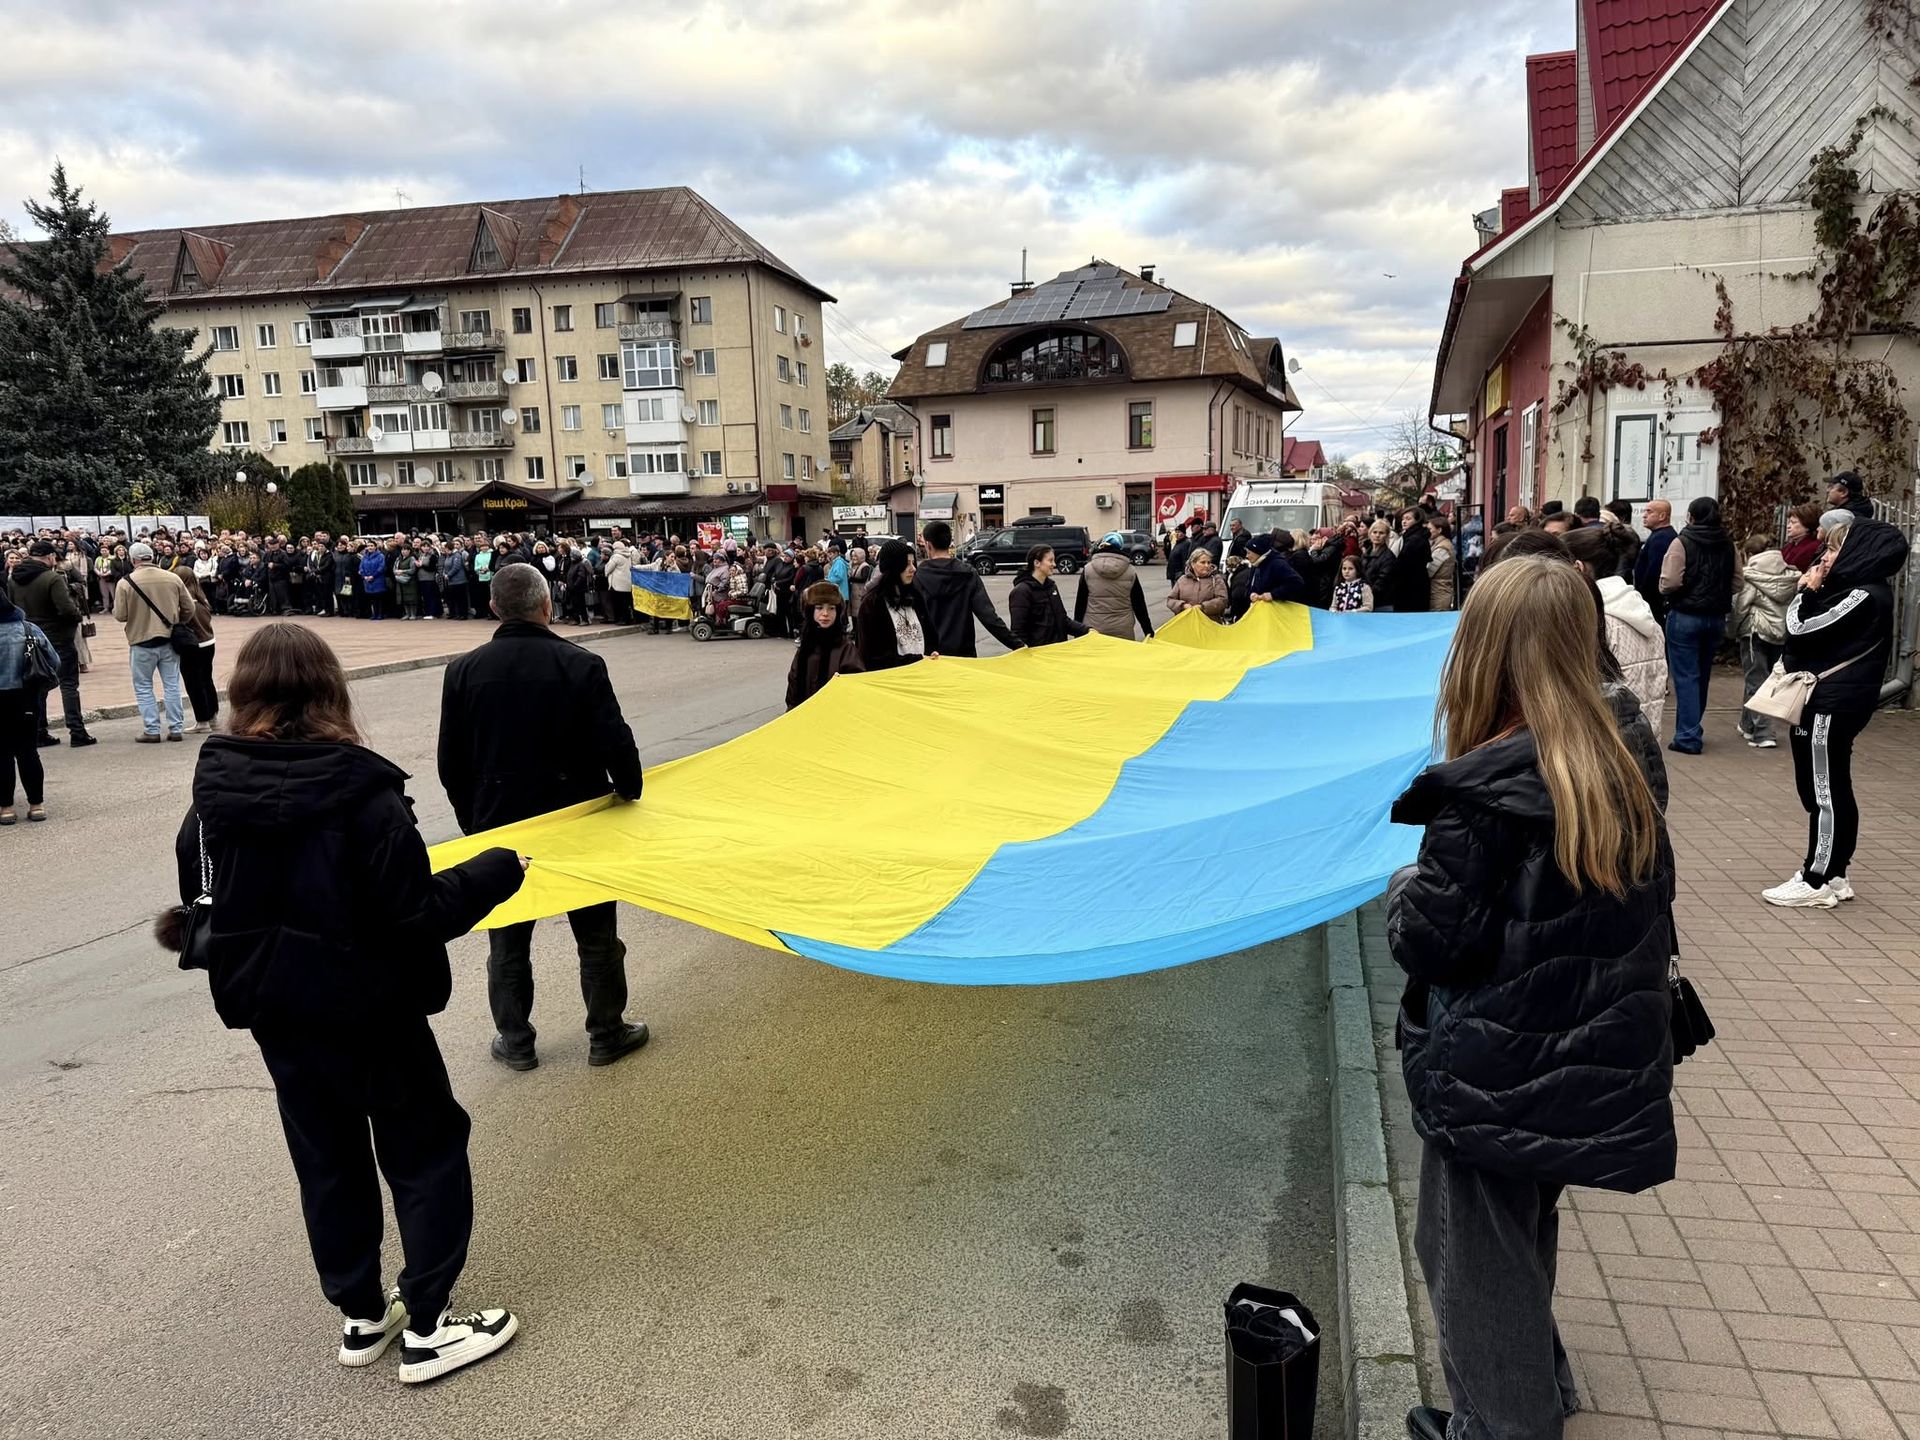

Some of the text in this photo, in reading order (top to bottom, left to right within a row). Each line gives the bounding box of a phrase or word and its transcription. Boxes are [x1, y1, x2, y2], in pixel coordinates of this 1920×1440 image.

[1668, 390, 1713, 403] ERFECT
[482, 496, 528, 510] Наш Край
